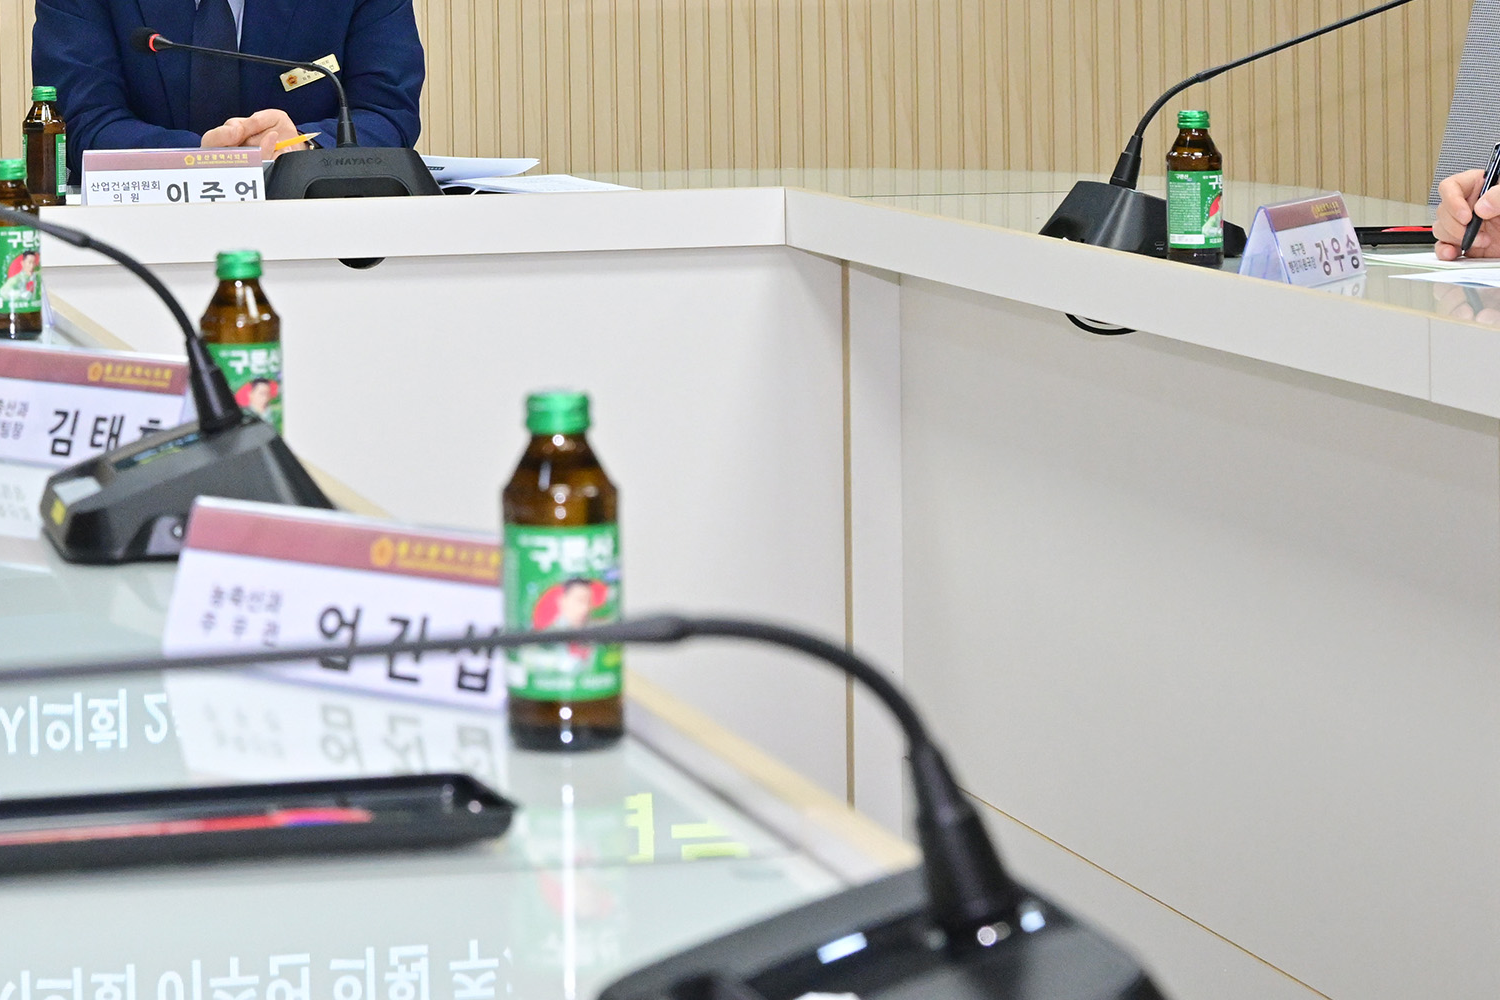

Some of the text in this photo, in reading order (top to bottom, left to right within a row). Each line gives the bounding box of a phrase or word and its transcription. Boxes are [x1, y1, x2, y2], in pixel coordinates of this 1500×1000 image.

[90, 180, 161, 192] 산업건설위원회
[165, 179, 258, 203] 이주언
[1314, 234, 1360, 276] 강우송
